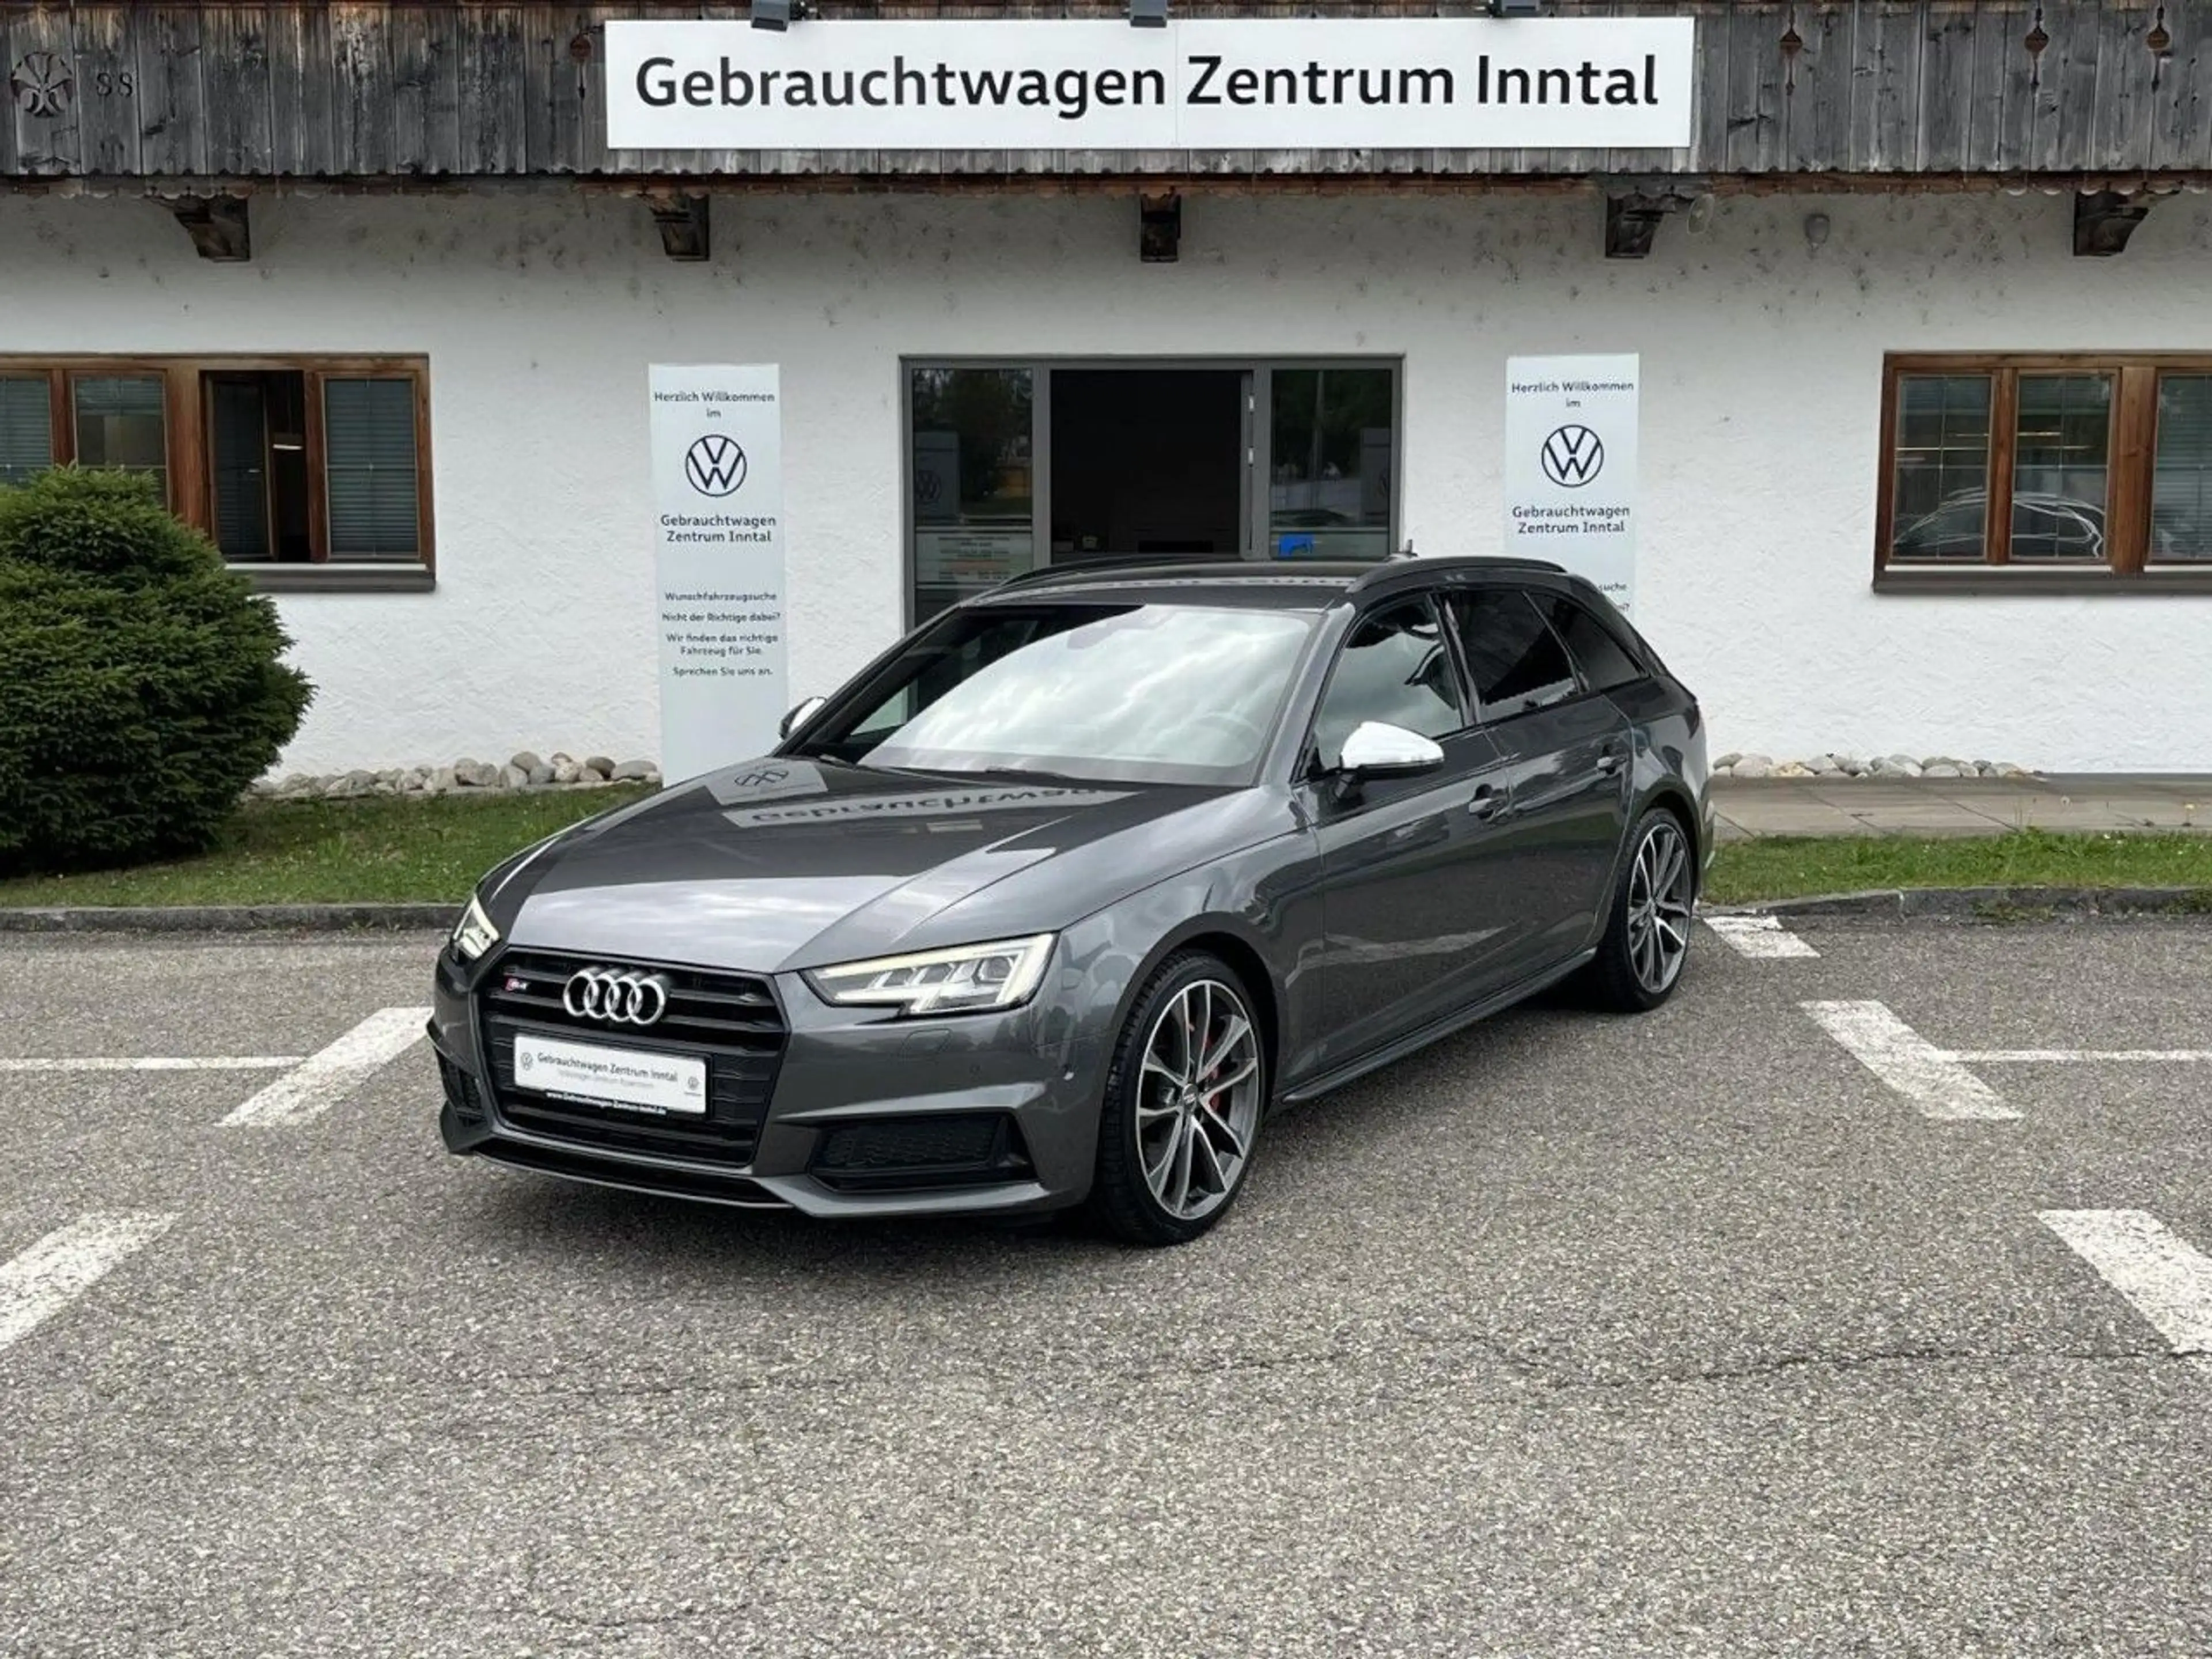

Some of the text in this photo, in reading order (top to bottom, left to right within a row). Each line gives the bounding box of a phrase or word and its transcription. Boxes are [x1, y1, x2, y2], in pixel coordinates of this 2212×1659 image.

[635, 54, 1659, 120] Gebrauchtwagen Zentrum Inntal
[1512, 381, 1634, 393] Herzlich Willkommen
[654, 391, 775, 402] Herzlich Willkommen
[1566, 398, 1581, 408] im
[706, 408, 721, 418] im
[1512, 506, 1630, 518] Gebrauchtwagen
[660, 514, 777, 528] Gebrauchtwagen
[1518, 521, 1624, 533] Zentrum Inntal
[666, 531, 772, 542] Zentrum Inntal
[665, 592, 777, 603] Wunschfahrzeugsuche
[662, 612, 781, 623] Nicht der Richtige dabei?
[666, 634, 778, 643] Wir finden das richtige
[680, 646, 726, 657] Fahrzeug
[728, 646, 743, 655] für
[672, 667, 718, 677] Sprechen
[720, 667, 735, 676] Sie
[537, 1052, 608, 1073] Gebrauchtwagen
[609, 1062, 649, 1077] Zentrum
